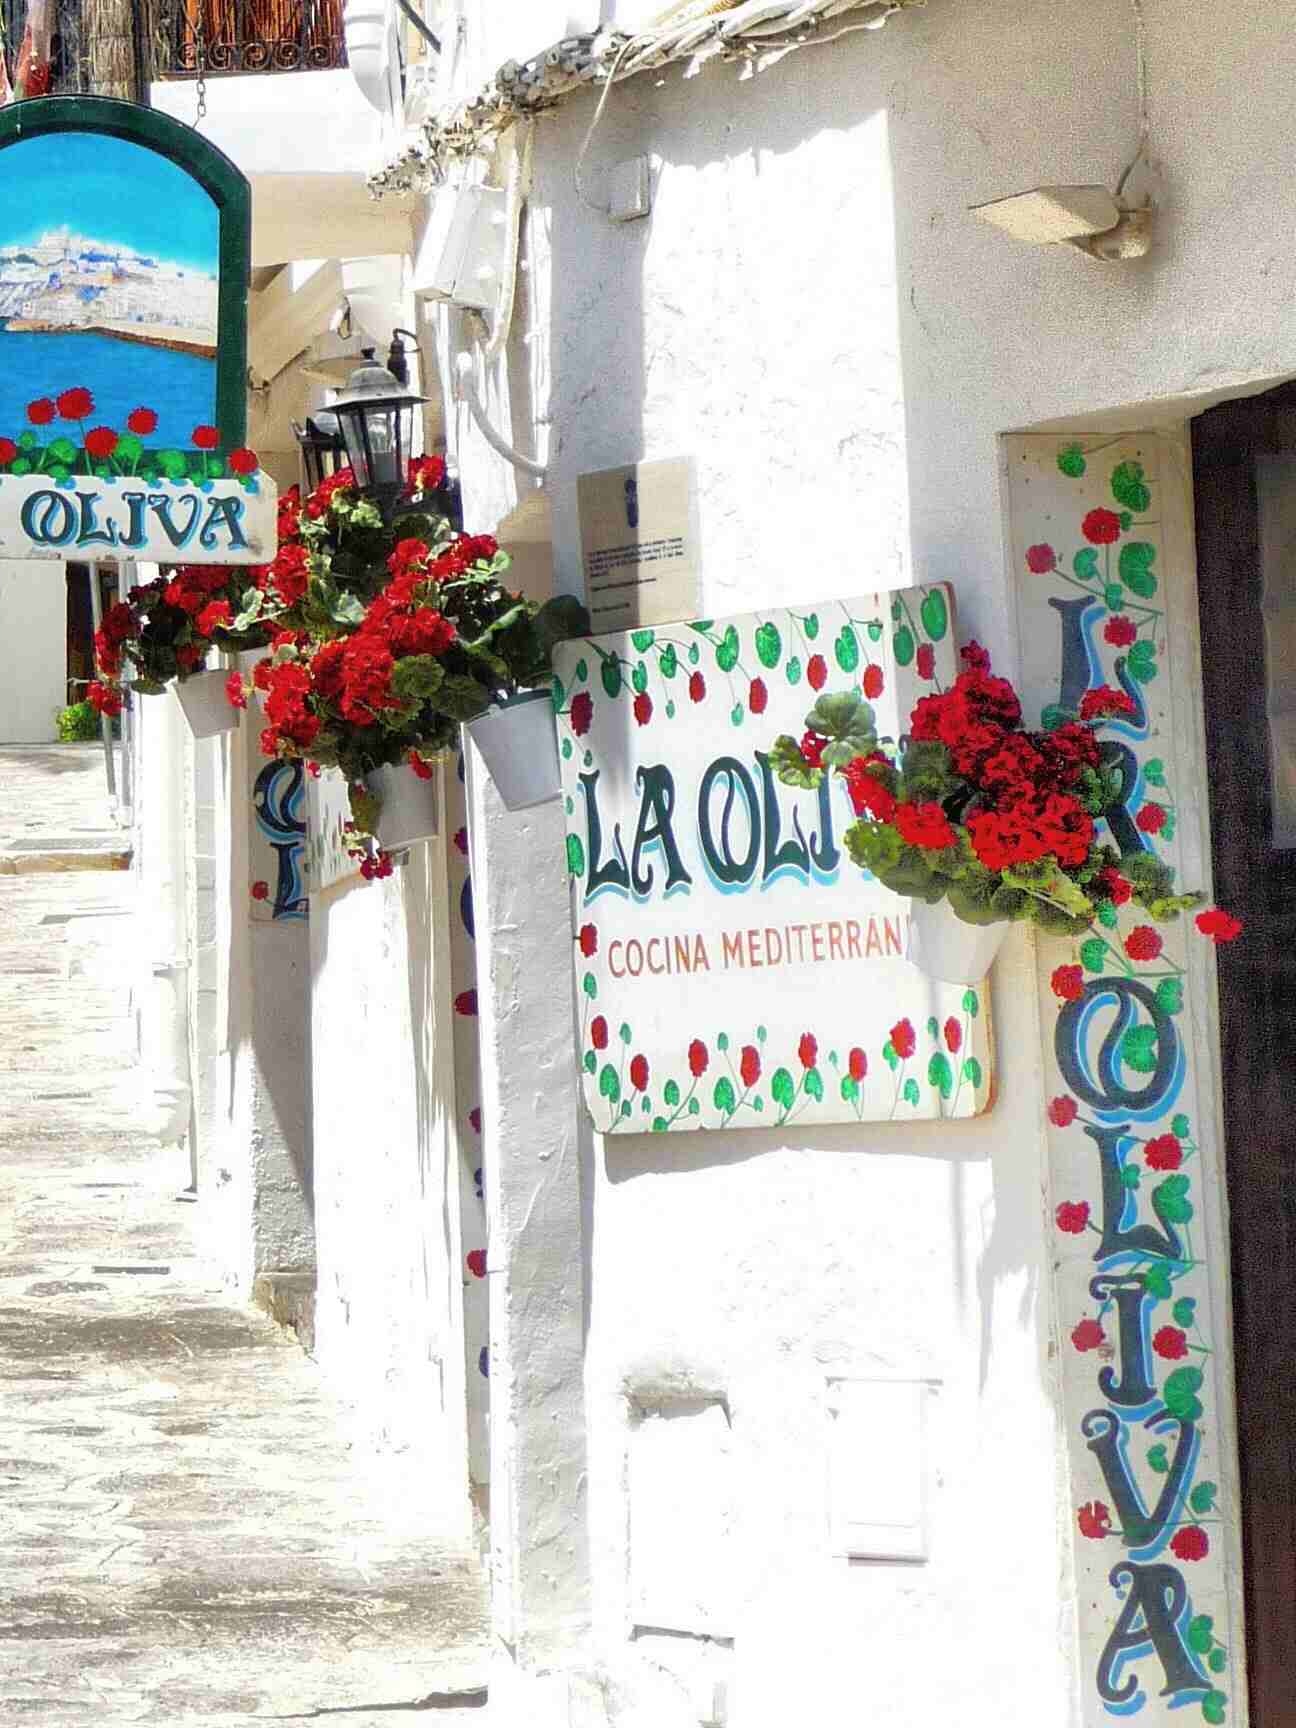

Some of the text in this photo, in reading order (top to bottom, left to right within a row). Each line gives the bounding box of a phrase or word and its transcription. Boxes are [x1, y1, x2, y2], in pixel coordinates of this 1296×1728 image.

[19, 489, 251, 551] OLIVA
[578, 745, 894, 904] LA OLI
[608, 932, 711, 978] COCINA
[1054, 975, 1212, 1707] OLIVA
